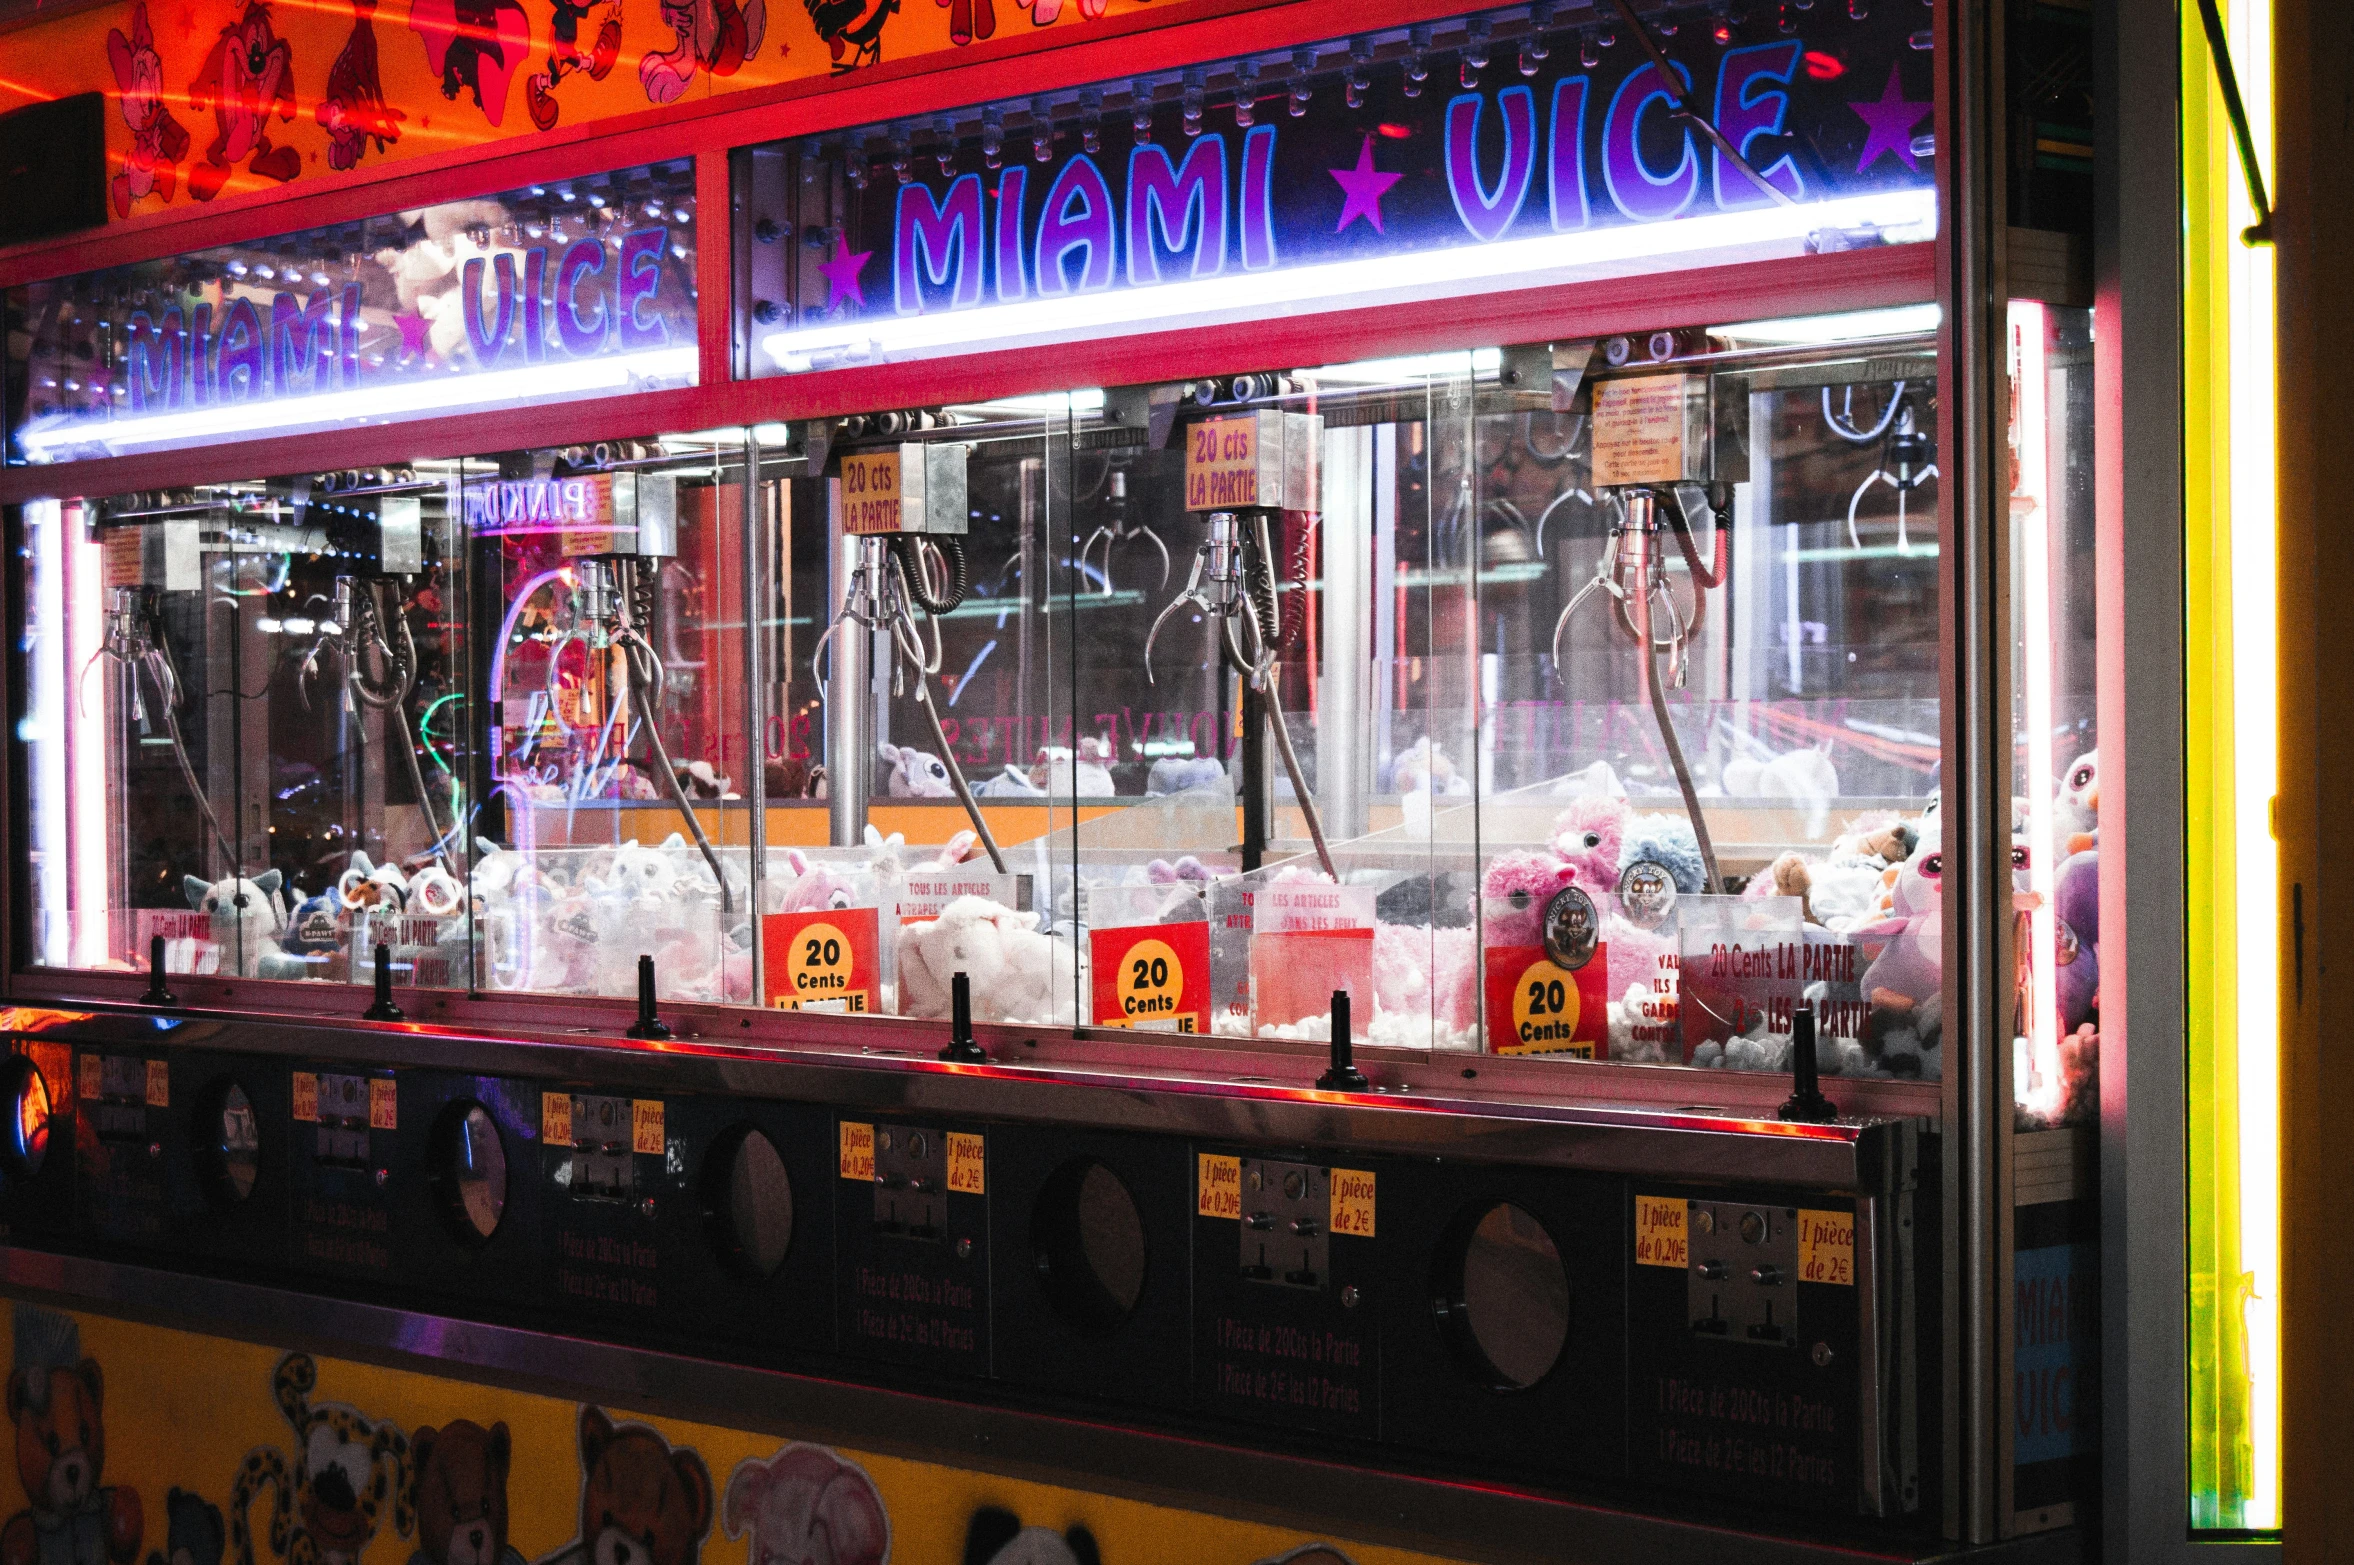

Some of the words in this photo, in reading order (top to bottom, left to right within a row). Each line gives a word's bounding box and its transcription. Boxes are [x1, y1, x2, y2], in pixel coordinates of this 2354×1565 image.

[893, 124, 1279, 317] MIAMI
[1444, 39, 1806, 243] VICE
[128, 282, 362, 413] MIAMI
[462, 226, 671, 369] VICE
[1196, 428, 1217, 463] 20
[1224, 428, 1248, 461] cts
[848, 461, 866, 494] 20
[872, 462, 892, 491] cts
[1190, 472, 1206, 506] LA
[1211, 469, 1256, 505] PARTIE
[844, 502, 858, 533] LA
[862, 499, 900, 532] PARTIE
[909, 882, 931, 896] TOUS
[934, 882, 947, 896] LES
[952, 882, 991, 896] ARTICLES
[1623, 866, 1645, 892] NICKY
[1272, 893, 1289, 908] LES
[1294, 893, 1340, 909] ARTICLES
[1548, 893, 1571, 924] NICKY
[401, 919, 409, 946] LA
[413, 919, 438, 947] PARTIE
[805, 939, 841, 968] 20
[1711, 943, 1728, 978] 20
[1731, 943, 1773, 979] Cents
[1778, 941, 1796, 980] LA
[1803, 943, 1855, 983] PARTIE
[797, 971, 845, 989] Cents
[1133, 957, 1168, 990] 20
[1124, 994, 1174, 1015] Cents
[1529, 980, 1565, 1015] 20
[1768, 996, 1792, 1035] LES
[1520, 1020, 1571, 1042] Cents
[635, 1105, 639, 1123] 1
[641, 1107, 664, 1129] pièce
[637, 1131, 648, 1151] de
[844, 1127, 849, 1146] 1
[850, 1129, 871, 1152] pièce
[948, 1138, 954, 1157] 1
[955, 1140, 985, 1164] pièce
[841, 1155, 851, 1174] de
[1205, 1160, 1211, 1179] 1
[1212, 1161, 1237, 1188] pièce
[951, 1169, 965, 1186] de
[967, 1170, 982, 1190] 2€
[1332, 1174, 1338, 1196] 1
[1339, 1177, 1375, 1203] pièce
[1200, 1189, 1212, 1209] de
[1334, 1208, 1351, 1230] de
[1353, 1209, 1370, 1232] 2€
[1643, 1204, 1649, 1226] 1
[1650, 1205, 1681, 1234] pièce
[1638, 1236, 1652, 1259] de
[1802, 1219, 1809, 1243] 1
[1812, 1222, 1854, 1250] pièce
[1805, 1258, 1825, 1280] de
[1828, 1257, 1849, 1282] 2€
[2016, 1274, 2086, 1348] MIA
